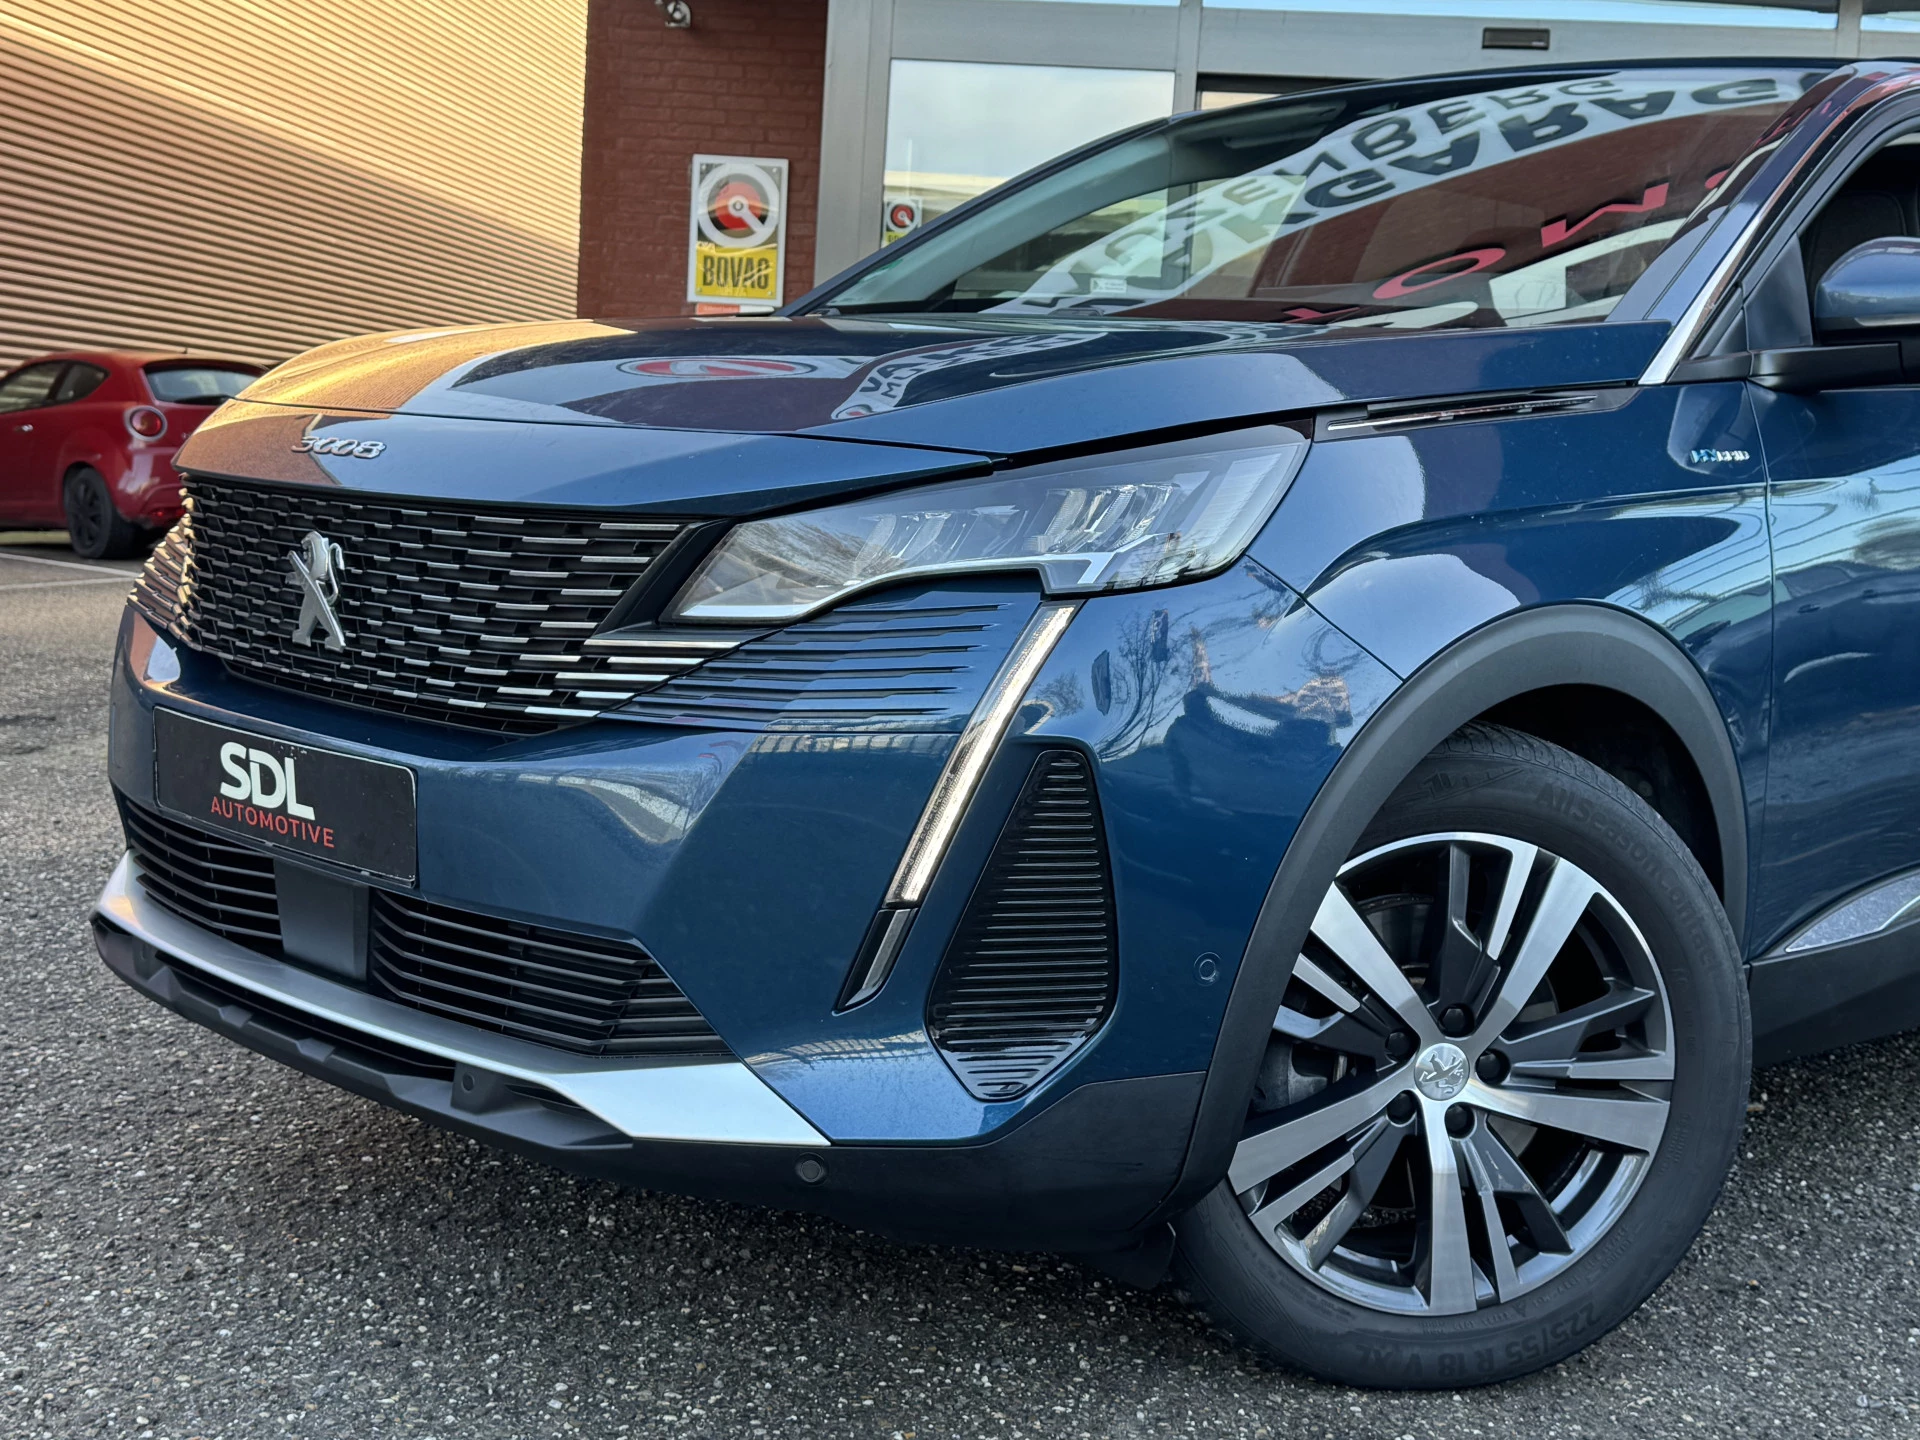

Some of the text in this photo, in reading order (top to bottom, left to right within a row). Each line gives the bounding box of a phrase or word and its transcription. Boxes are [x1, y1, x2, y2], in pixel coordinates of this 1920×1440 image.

[703, 255, 770, 290] BOVAG
[291, 436, 386, 459] 3008
[220, 742, 315, 820] SDL
[210, 796, 335, 848] AUTOMOTIVE
[1505, 1303, 1597, 1360] 225/55
[1438, 1352, 1469, 1378] 18
[1477, 1351, 1495, 1373] R
